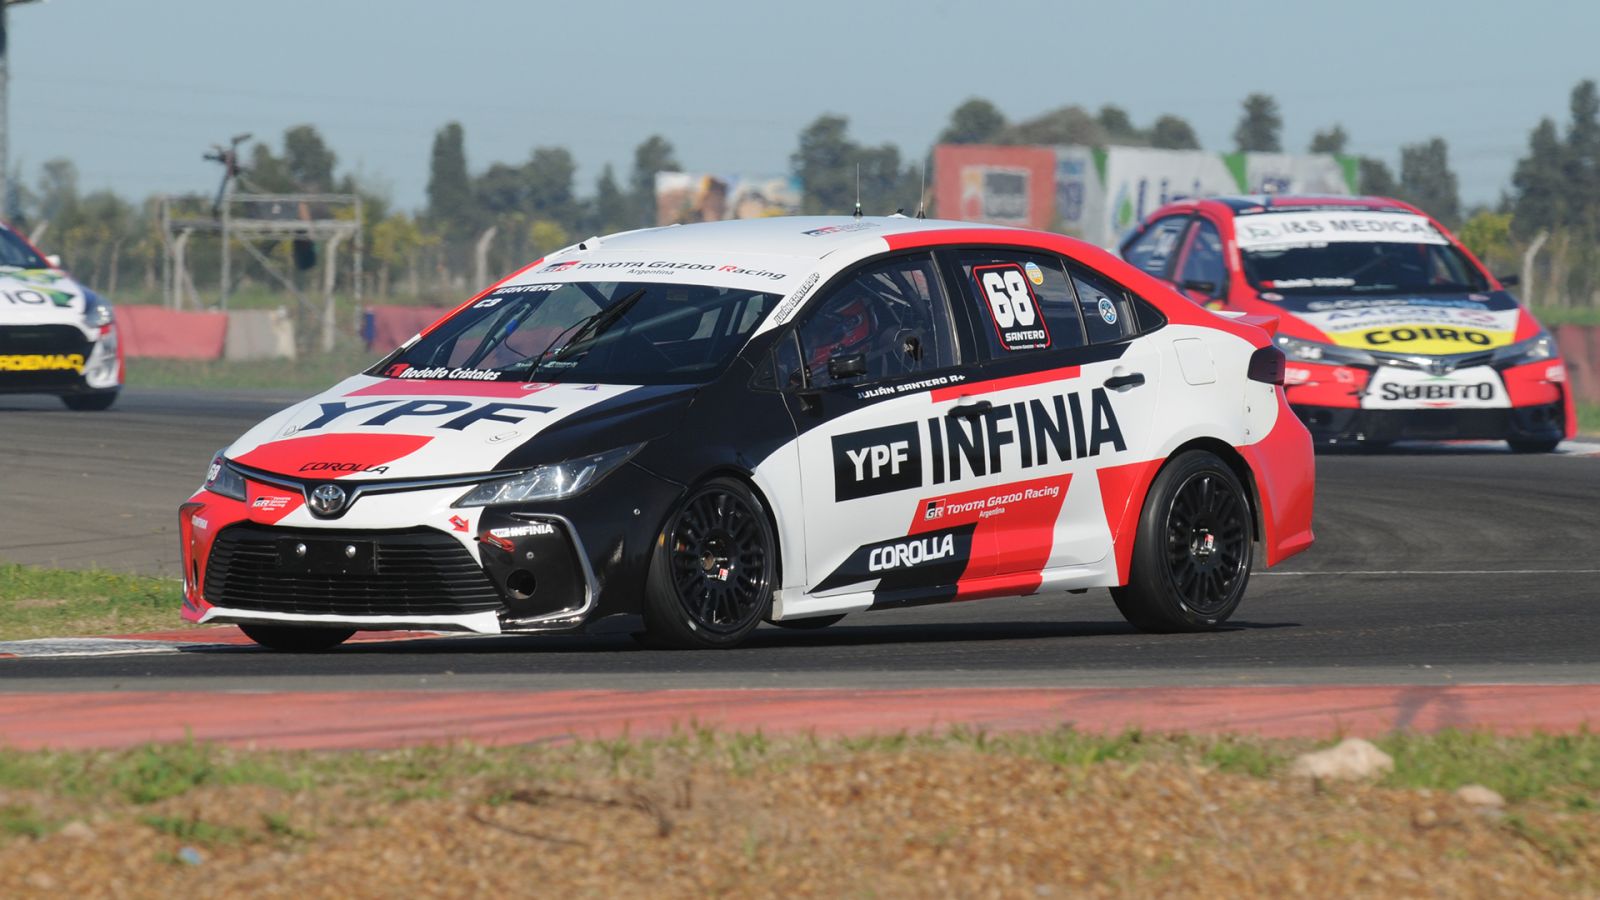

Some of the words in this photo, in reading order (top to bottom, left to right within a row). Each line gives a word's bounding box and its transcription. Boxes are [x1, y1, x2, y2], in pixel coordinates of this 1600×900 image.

[1281, 219, 1324, 234] I&S
[578, 261, 644, 270] TOYOTA
[647, 261, 716, 271] GAZOO
[718, 265, 787, 280] Racing
[492, 284, 563, 295] SANTERO
[983, 271, 1036, 328] 68
[1005, 330, 1046, 342] SANTERO
[1365, 328, 1491, 346] COIRO
[399, 366, 449, 379] Rodolfo
[449, 367, 502, 381] Cristales
[857, 386, 895, 399] JULIÁN
[897, 376, 948, 392] SANTERO
[1381, 382, 1495, 401] SUBITO
[298, 400, 559, 431] YPF
[846, 440, 910, 482] YPF
[928, 387, 1127, 485] INFINIA
[299, 461, 390, 474] COROLLA
[946, 500, 985, 515] TOYOTA
[987, 493, 1023, 507] GAZOO
[1024, 486, 1060, 499] Racing
[924, 506, 944, 519] GR
[979, 507, 1006, 518] Argentina
[510, 524, 554, 537] INFINIA
[869, 534, 955, 571] COROLLA
